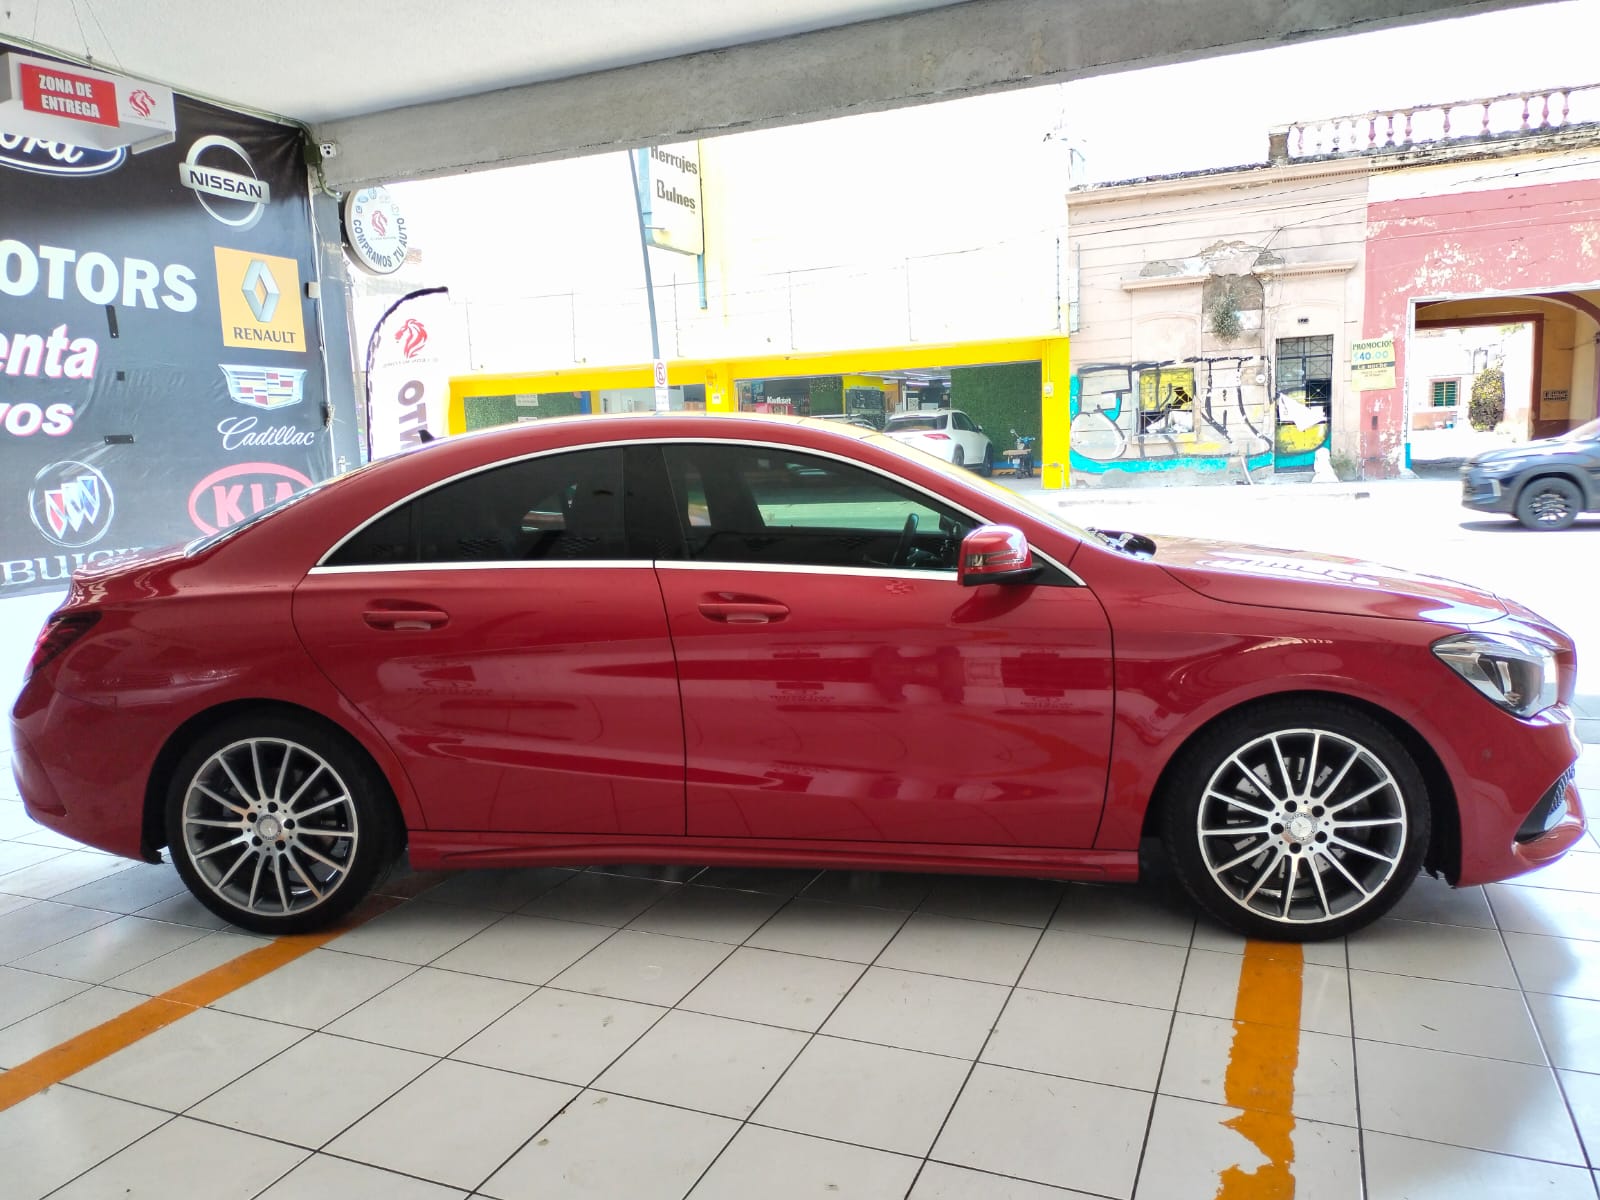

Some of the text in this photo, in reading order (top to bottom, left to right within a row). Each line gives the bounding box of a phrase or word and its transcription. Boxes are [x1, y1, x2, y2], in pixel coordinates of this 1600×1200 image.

[39, 74, 93, 97] ZONA DE
[41, 94, 100, 118] ENTREGA
[651, 144, 698, 174] Herrajes
[189, 170, 263, 199] NISSAN
[657, 178, 696, 209] Bulnes
[353, 217, 408, 267] COMPRAMOS TU AUTO
[233, 326, 296, 343] RENAULT
[0, 324, 98, 379] nta
[217, 416, 315, 450] Cadillac
